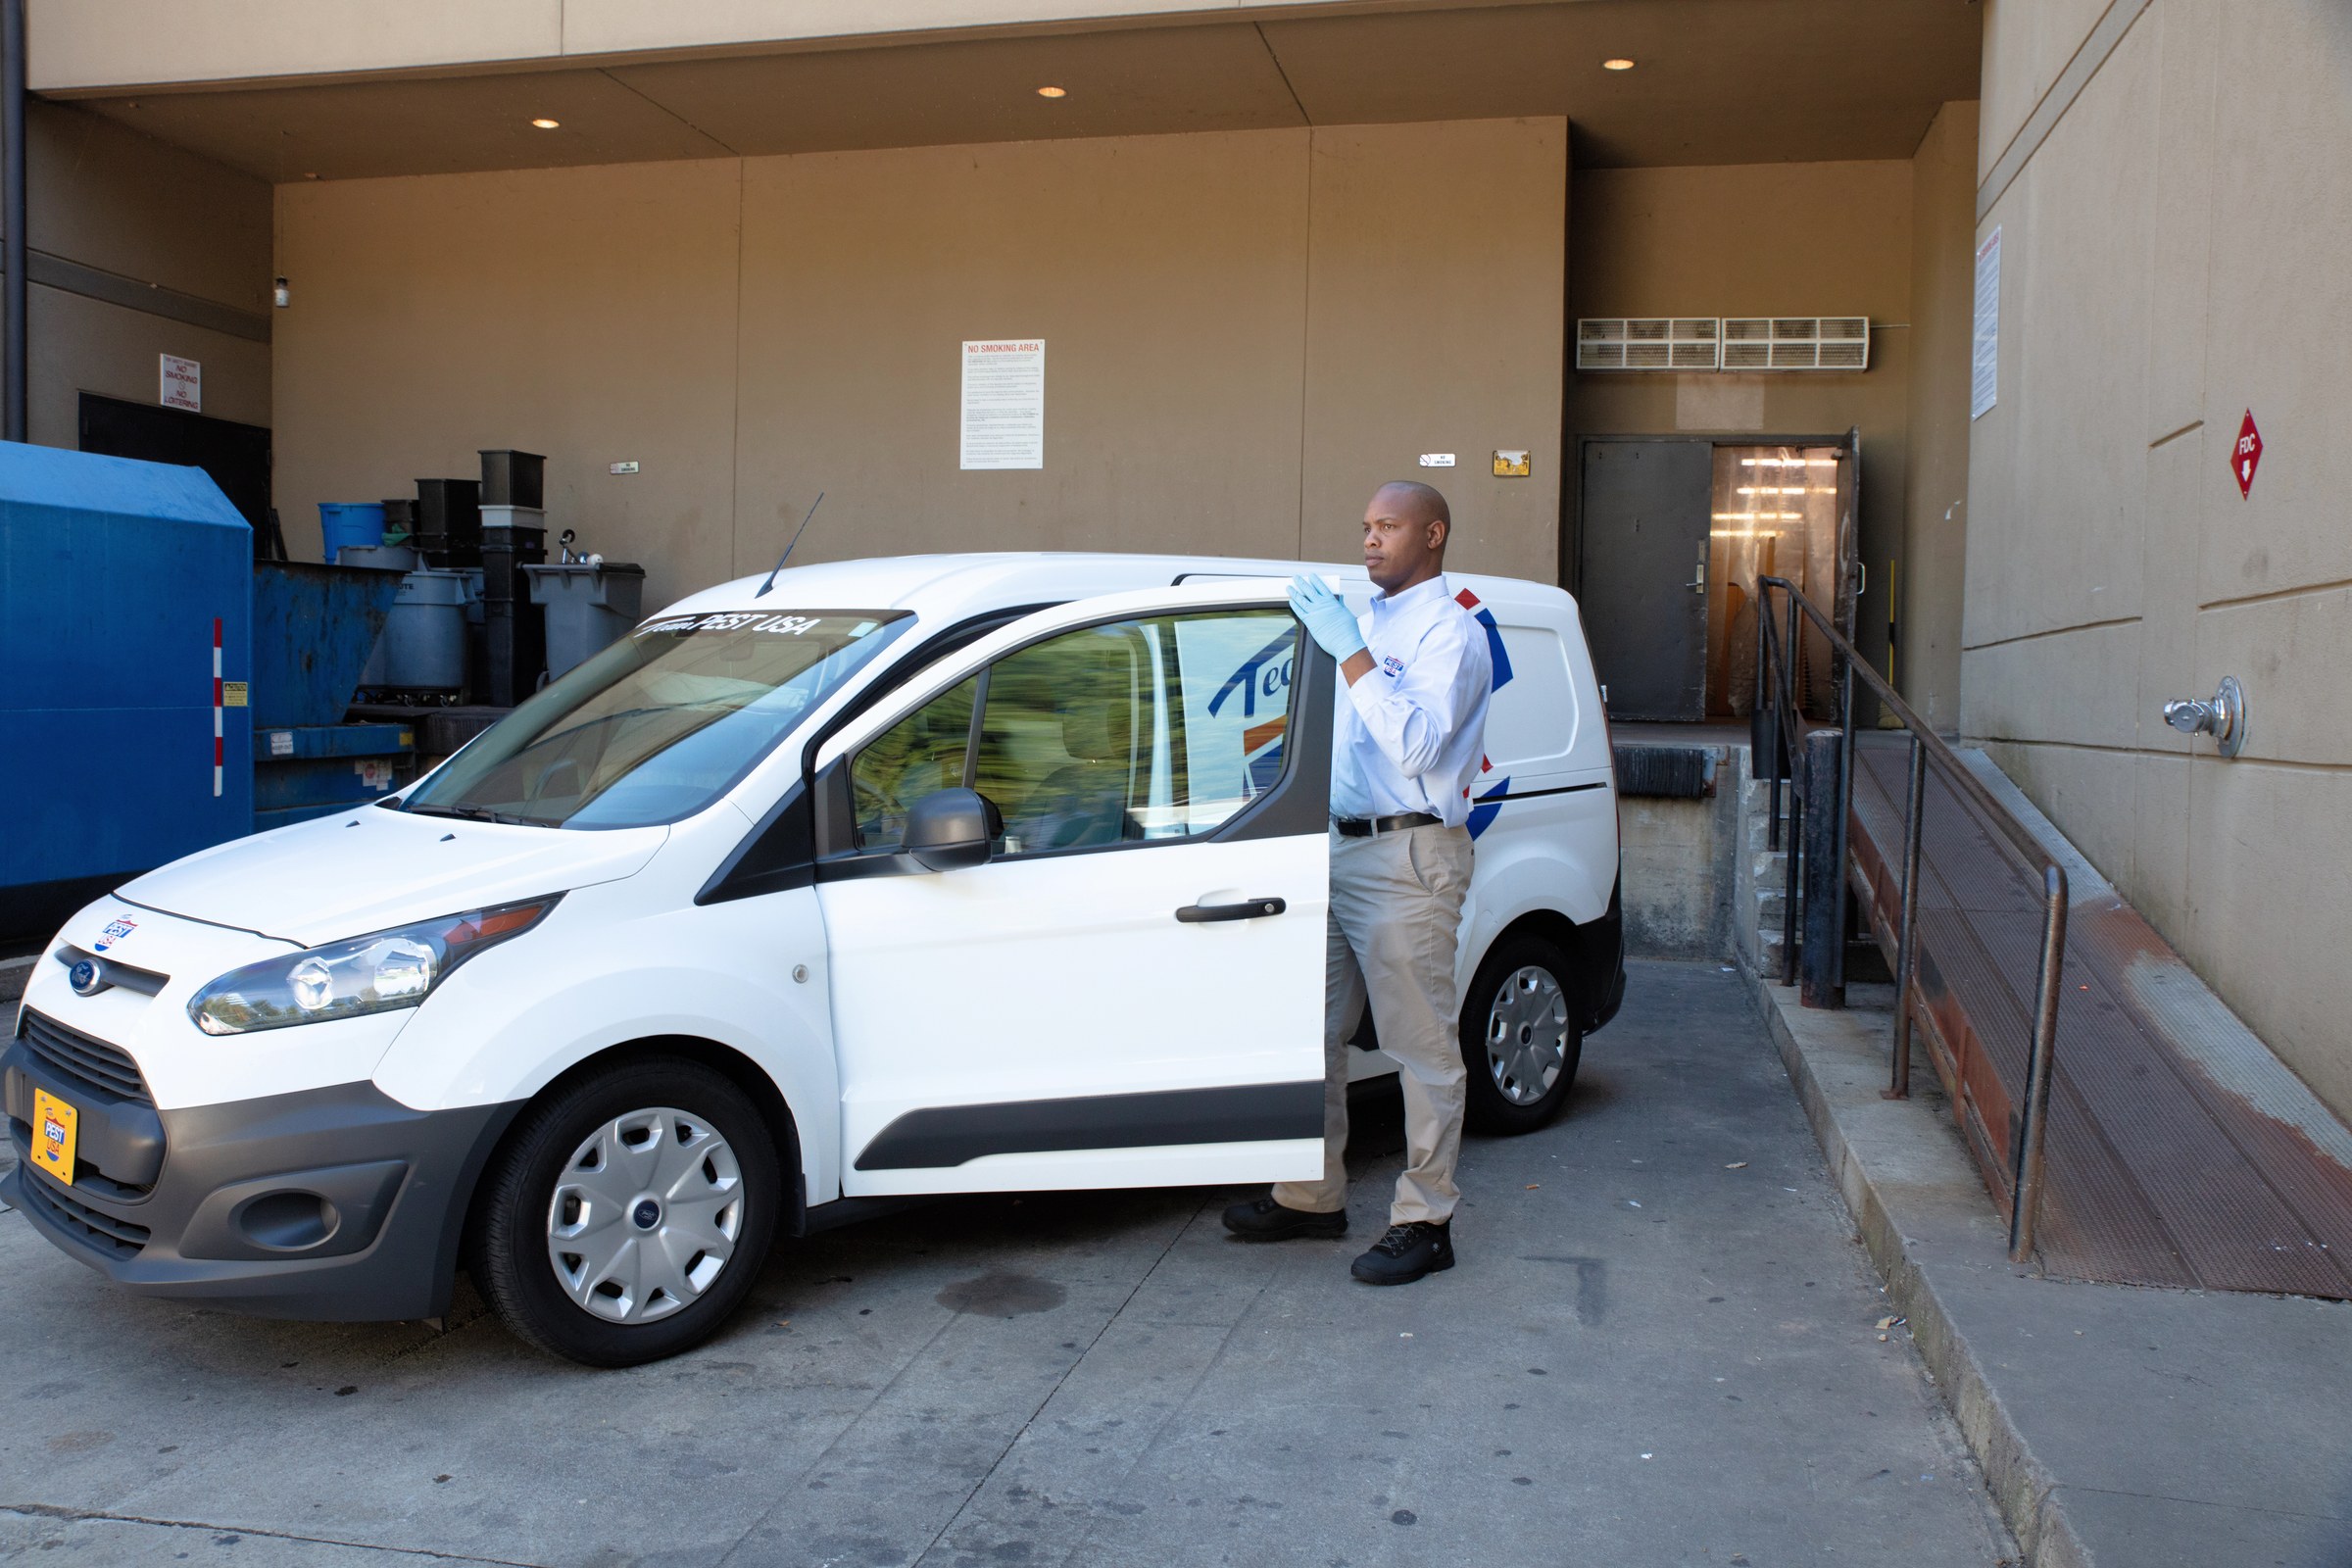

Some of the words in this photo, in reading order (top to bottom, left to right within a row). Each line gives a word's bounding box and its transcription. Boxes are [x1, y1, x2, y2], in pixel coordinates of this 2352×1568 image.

[967, 345, 979, 354] NO
[981, 344, 1016, 353] SMOKING
[1018, 343, 1039, 352] AREA
[175, 365, 187, 373] NO
[166, 370, 198, 385] SMOKING
[175, 390, 187, 399] NO
[165, 396, 199, 410] LOITERING
[2238, 432, 2256, 456] FDC
[687, 613, 768, 630] PEST
[752, 614, 821, 636] USA
[45, 1121, 65, 1144] PEST
[47, 1138, 60, 1154] USA
